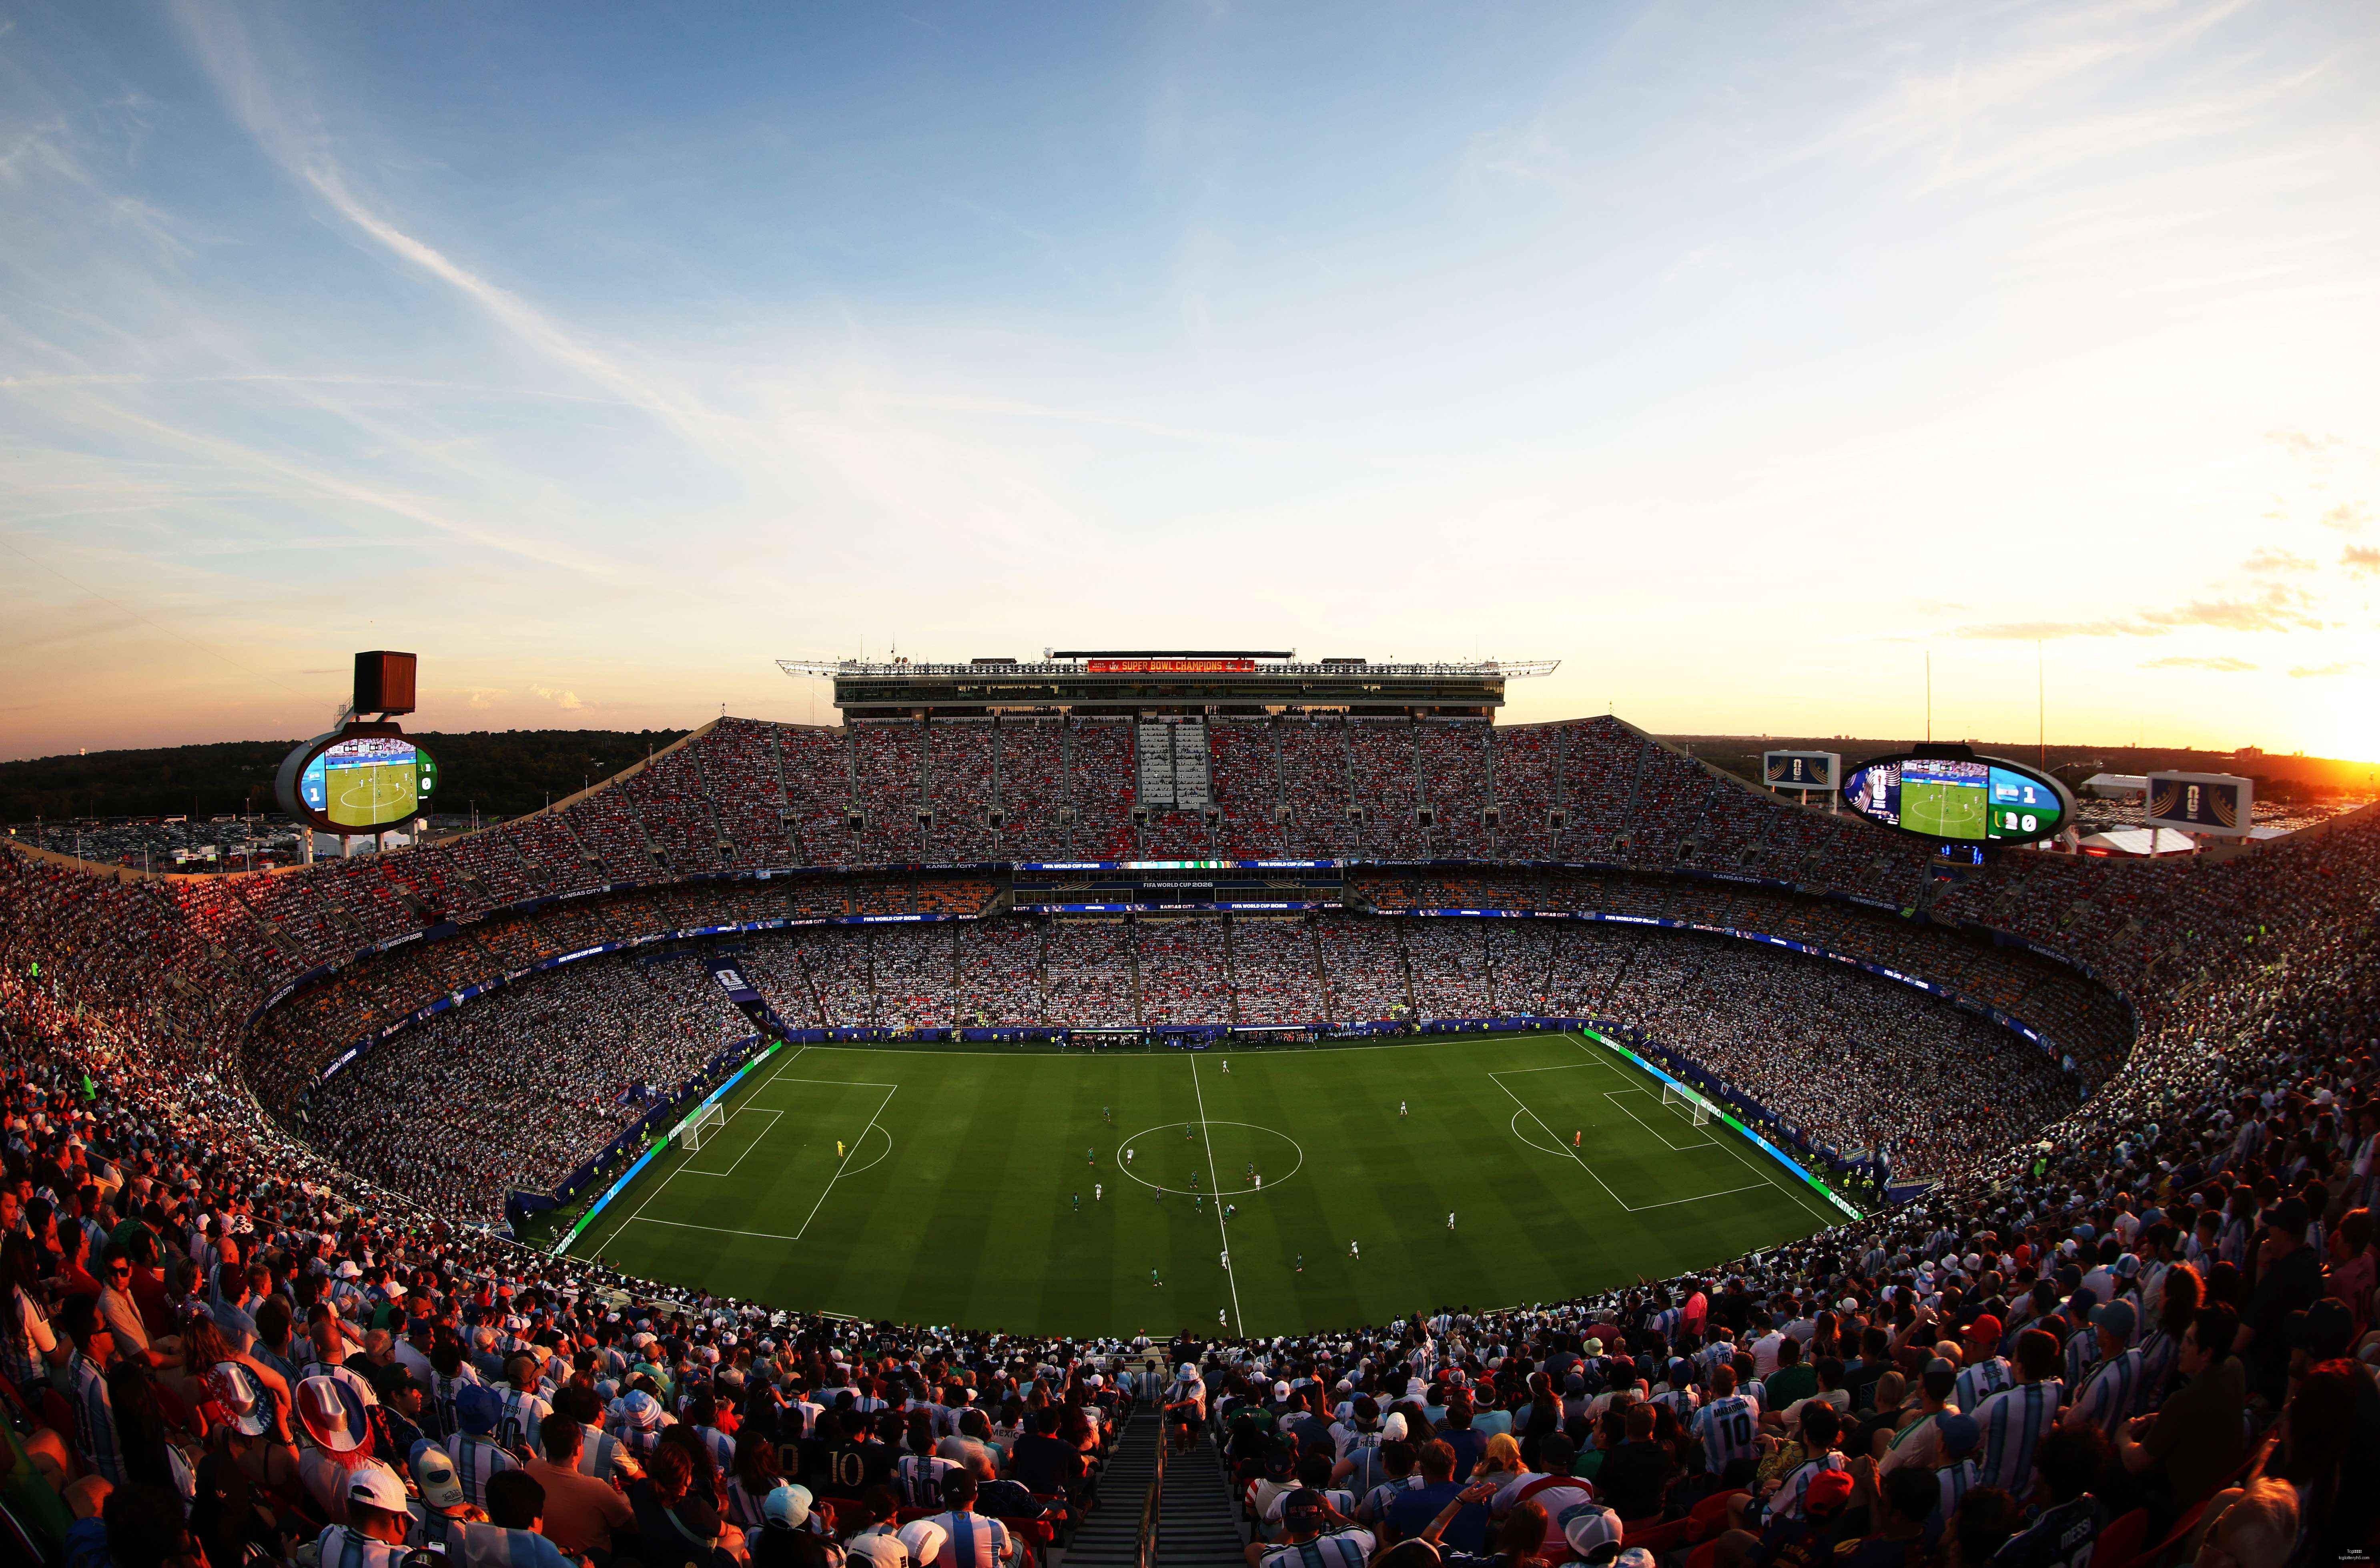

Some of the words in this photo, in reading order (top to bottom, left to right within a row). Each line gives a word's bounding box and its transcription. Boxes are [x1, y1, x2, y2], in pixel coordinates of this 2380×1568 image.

[1122, 661, 1147, 670] SUPER
[1151, 661, 1173, 670] BOWL
[1176, 661, 1222, 670] CHAMPIONS
[422, 777, 431, 790] 0
[311, 788, 320, 801] 1
[2024, 787, 2036, 803] 1
[2022, 815, 2036, 831] 0
[559, 891, 585, 899] KANSAS
[388, 939, 402, 948] WORLD
[409, 932, 423, 940] 2026
[283, 984, 295, 996] CITY
[1600, 1036, 1620, 1051] aramco
[754, 1049, 770, 1066] aramco
[596, 1153, 604, 1163] FIFA
[1829, 1192, 1859, 1220] aramco
[437, 1383, 454, 1393] MESSI
[502, 1403, 521, 1415] MESSI
[1714, 1401, 1748, 1417] MARADONA
[1720, 1413, 1750, 1451] 10
[829, 1452, 864, 1486] 10
[914, 1465, 934, 1474] MESSI
[910, 1476, 941, 1508] 10
